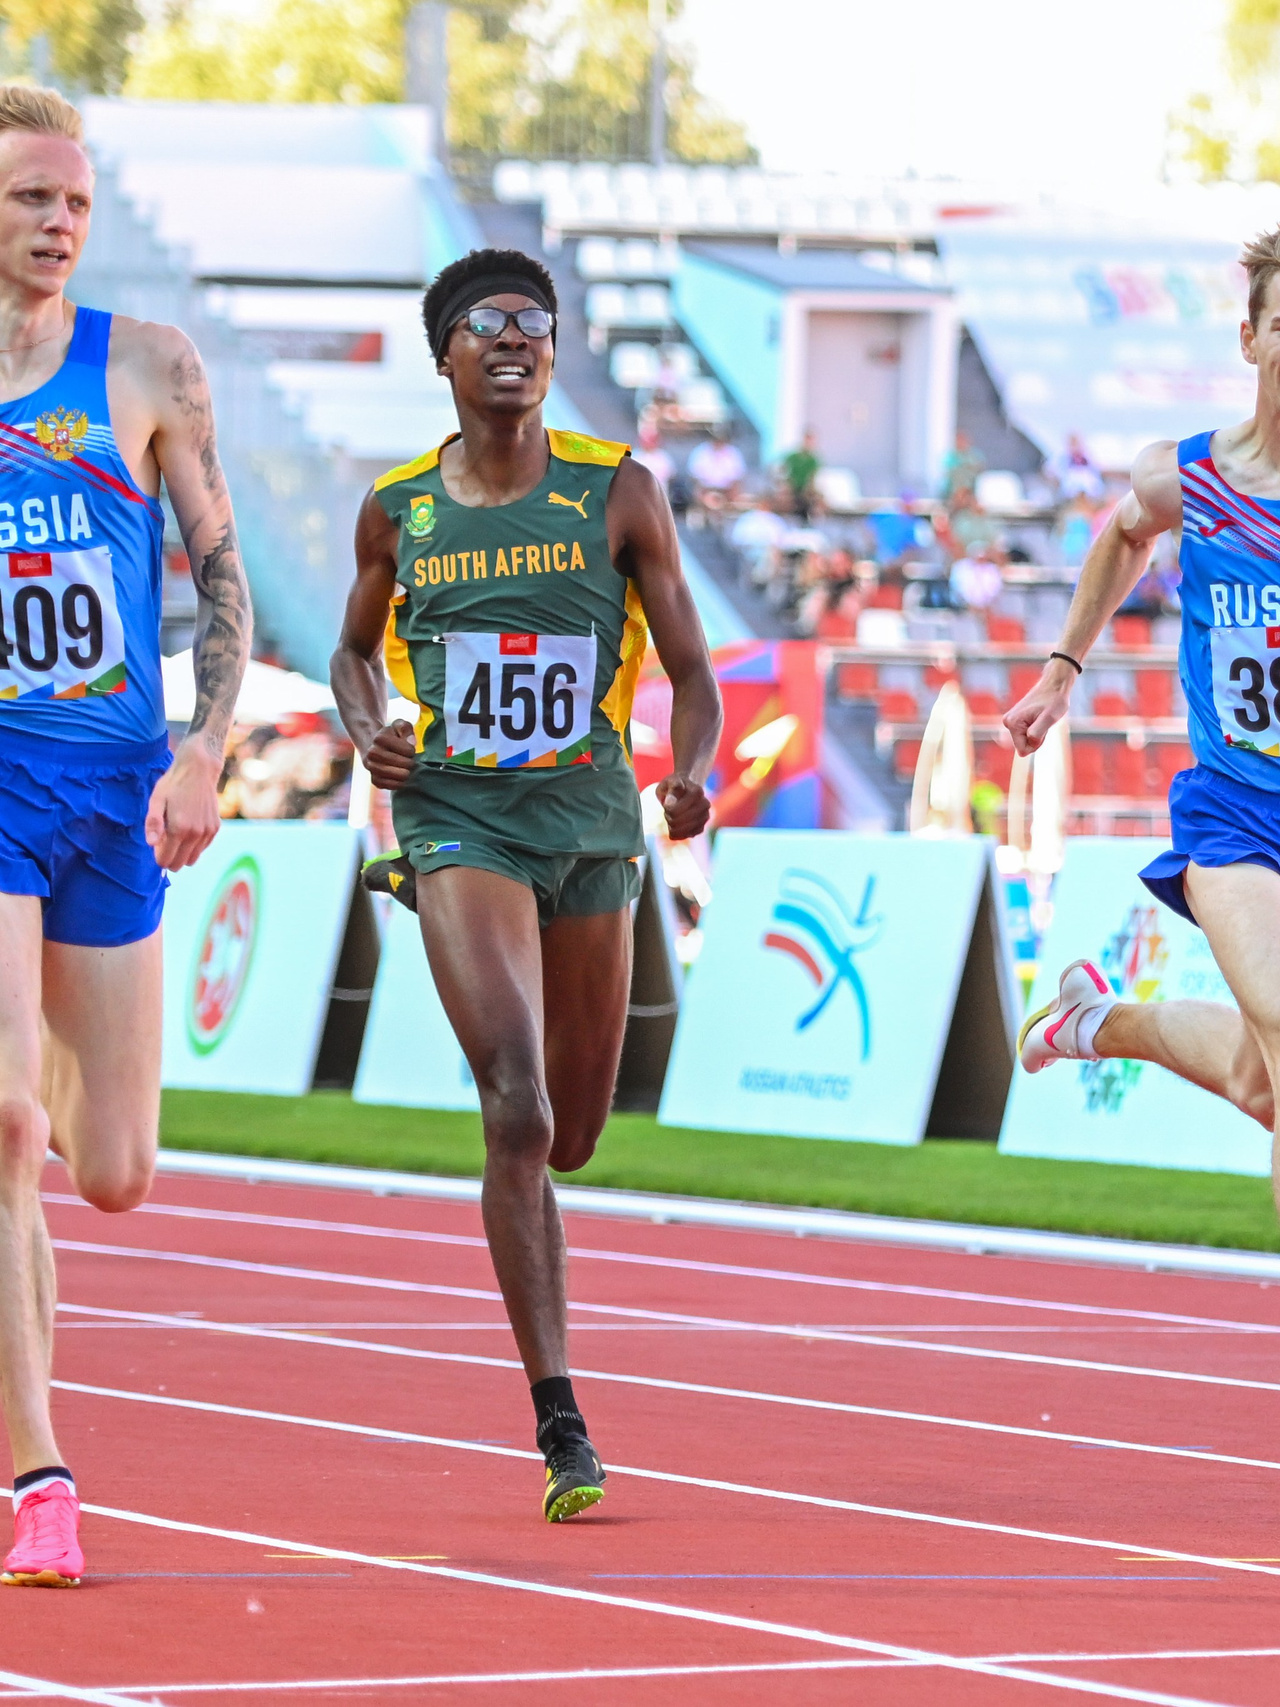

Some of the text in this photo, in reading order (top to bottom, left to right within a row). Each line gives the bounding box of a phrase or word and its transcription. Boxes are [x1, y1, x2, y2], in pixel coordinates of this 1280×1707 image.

[413, 541, 586, 587] SOUTH AFRICA
[458, 662, 577, 741] 456
